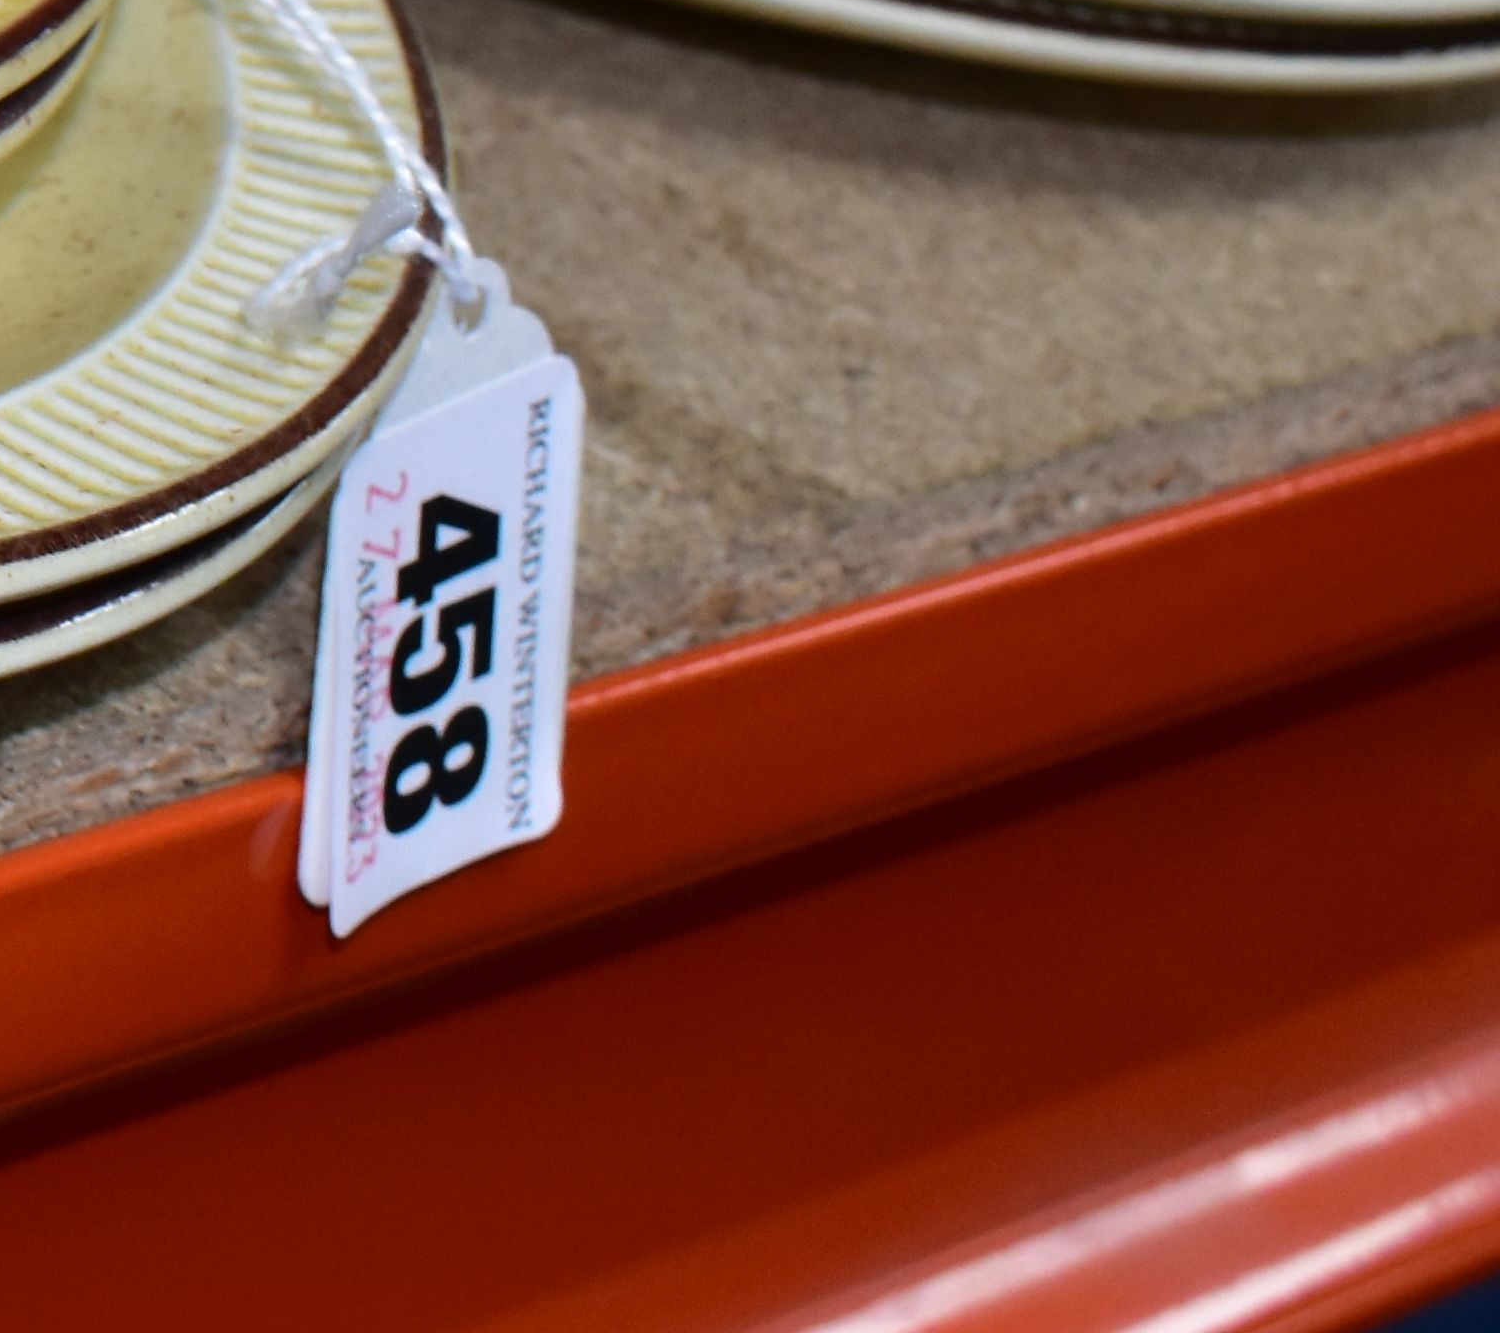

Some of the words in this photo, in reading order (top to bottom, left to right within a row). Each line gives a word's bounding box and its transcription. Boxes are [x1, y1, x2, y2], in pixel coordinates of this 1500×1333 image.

[518, 395, 552, 581] RICHARD
[382, 493, 502, 836] 458
[507, 589, 543, 831] WINTERTON
